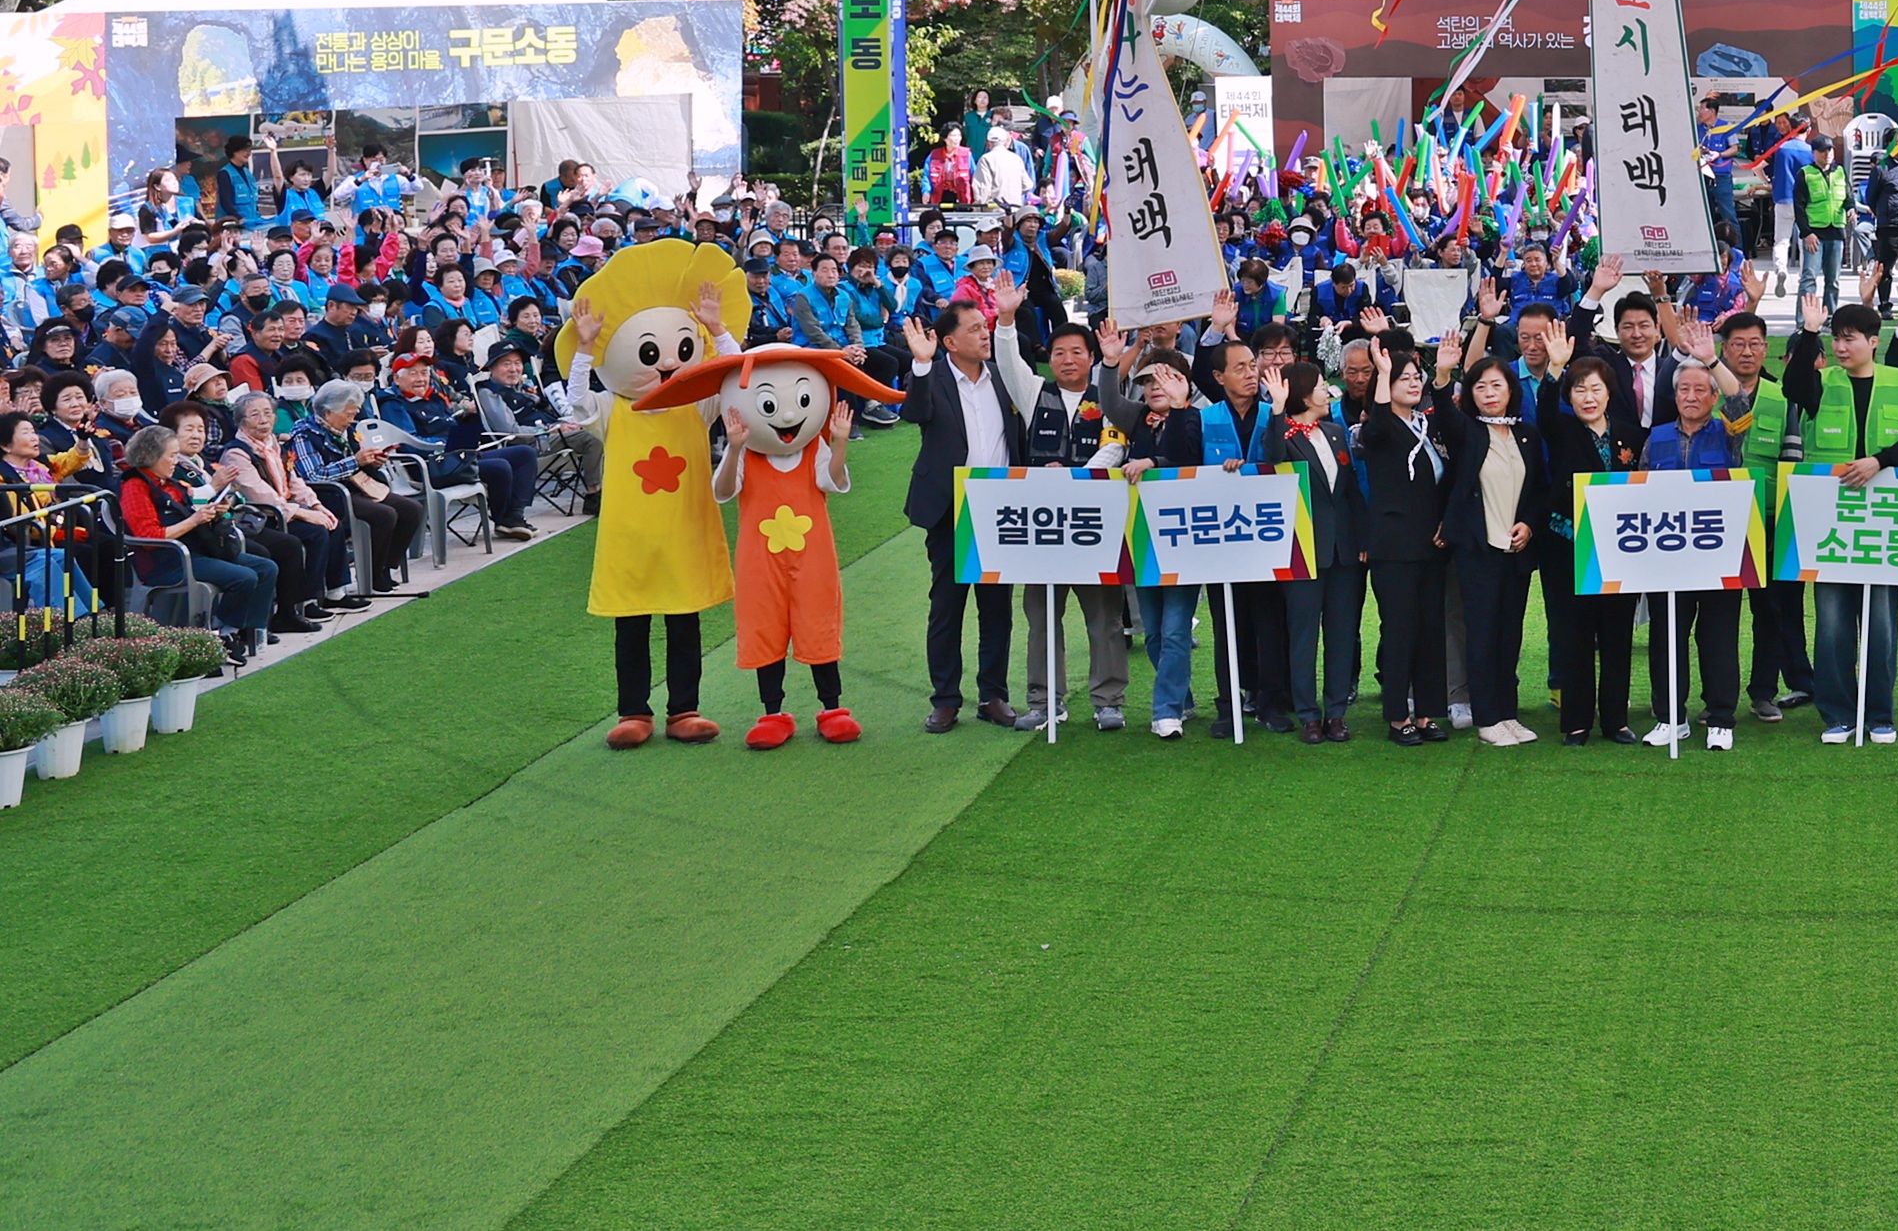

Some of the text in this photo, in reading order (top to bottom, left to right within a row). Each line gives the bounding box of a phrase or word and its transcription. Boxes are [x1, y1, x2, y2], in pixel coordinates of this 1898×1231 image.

[315, 30, 420, 53] 전통과 상상이
[1436, 16, 1479, 32] 석탄의
[1498, 33, 1542, 49] 역사가
[1546, 33, 1575, 49] 있는
[316, 52, 367, 73] 만나는
[371, 51, 404, 72] 용의
[449, 26, 578, 68] 구문소동
[1226, 91, 1261, 101] 제44회
[851, 149, 868, 182] 그때
[1619, 94, 1667, 207] 태백
[871, 130, 888, 212] 그때 그 맛
[1122, 137, 1172, 249] 태백
[995, 506, 1104, 546] 철암동
[1158, 502, 1286, 547] 구문소동
[1616, 509, 1725, 554] 장성동
